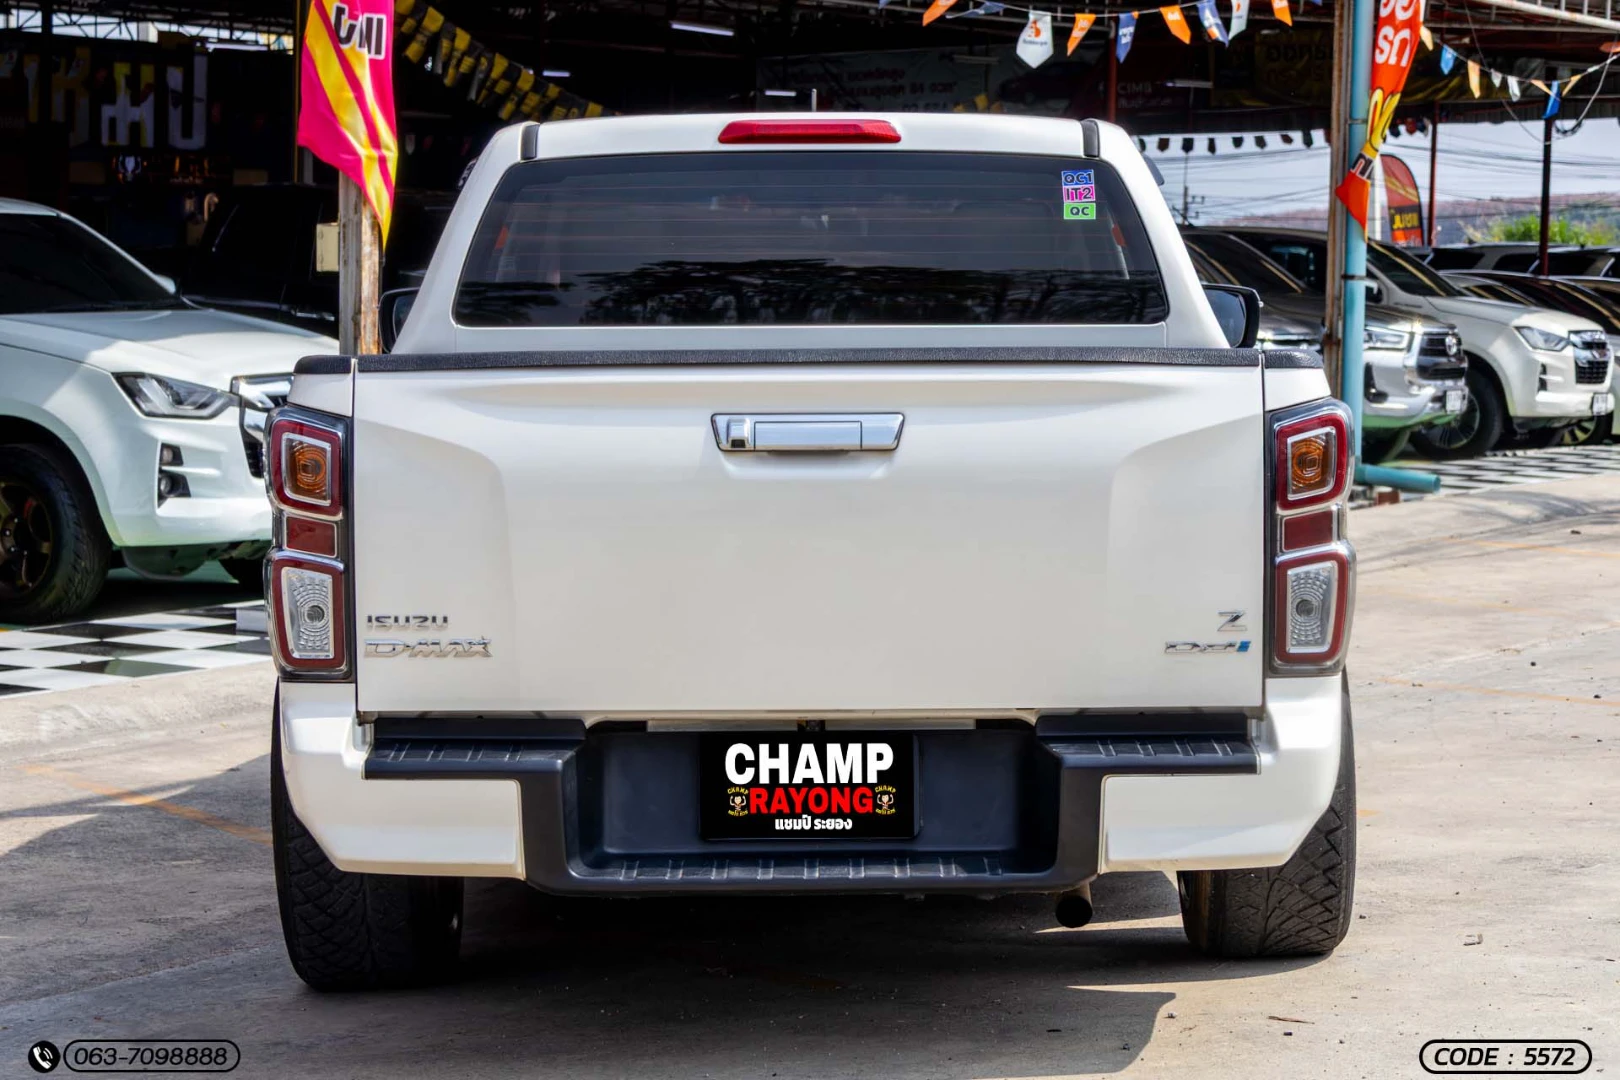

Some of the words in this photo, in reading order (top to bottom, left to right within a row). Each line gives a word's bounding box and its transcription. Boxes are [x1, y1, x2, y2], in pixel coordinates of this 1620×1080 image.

[1064, 172, 1093, 184] QC1
[1066, 187, 1092, 201] IT2
[1070, 206, 1090, 216] QC
[367, 615, 448, 631] ISUZU
[1217, 610, 1248, 632] Z
[364, 638, 492, 658] D-MAX
[725, 743, 894, 785] CHAMP
[750, 787, 873, 814] RAYONG
[813, 818, 853, 830] ระยอง
